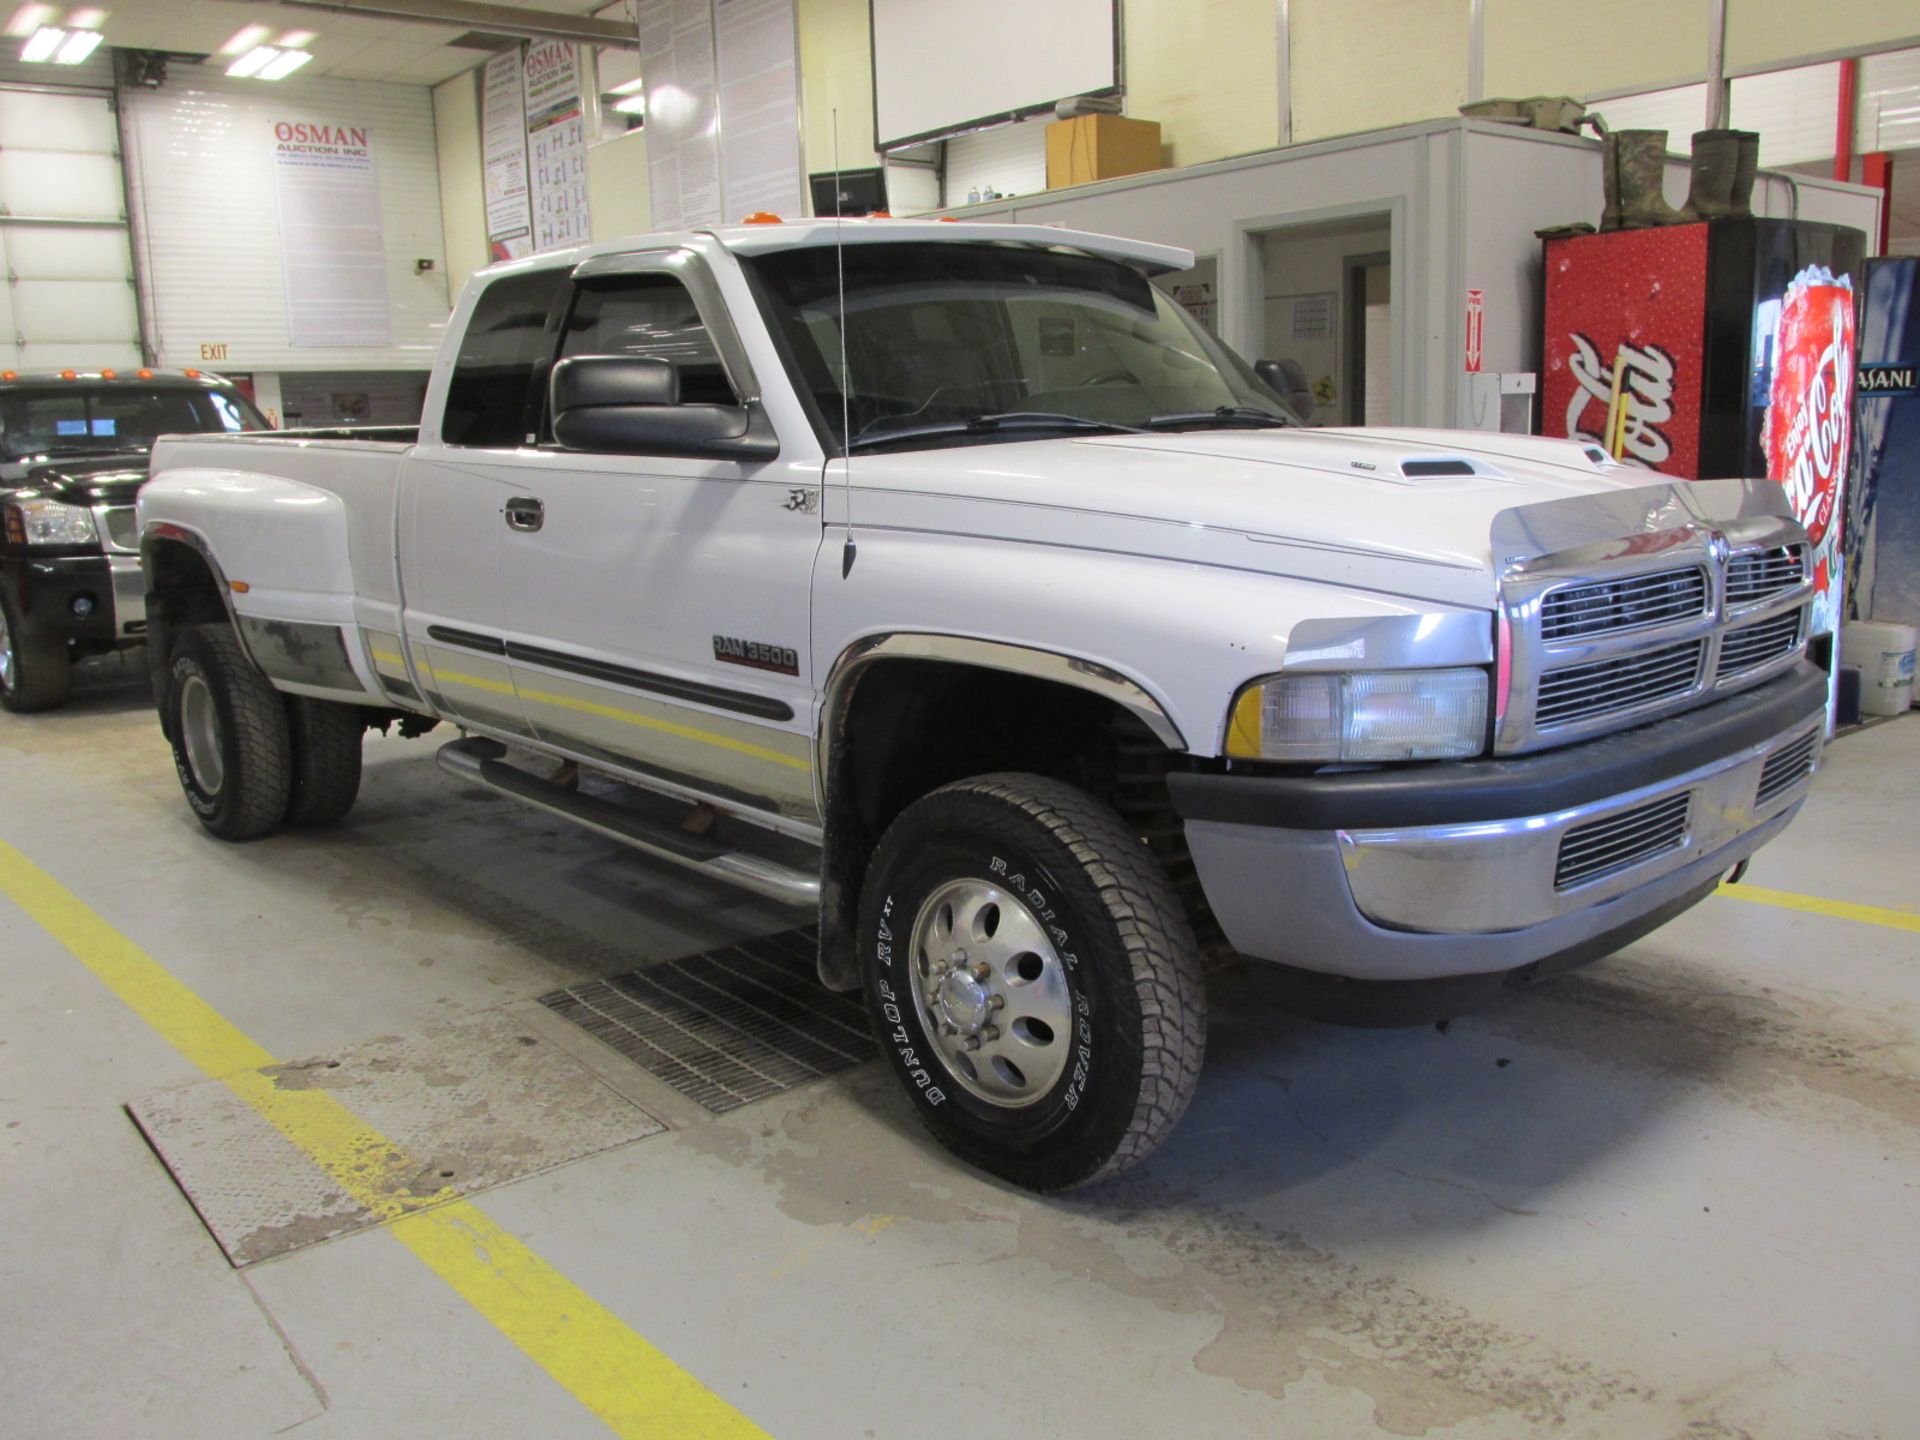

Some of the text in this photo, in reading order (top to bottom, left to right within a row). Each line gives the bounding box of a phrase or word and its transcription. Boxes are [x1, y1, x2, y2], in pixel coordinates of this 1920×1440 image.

[527, 40, 574, 78] OSMAN
[528, 68, 560, 88] AUCTION
[275, 121, 369, 147] OSMAN
[277, 143, 368, 157] AUCTION INC
[200, 344, 229, 361] EXIT
[1785, 397, 1810, 458] Enjoy
[713, 634, 746, 657] RAM
[747, 641, 797, 667] 3500
[877, 916, 895, 967] RV
[989, 855, 1091, 1112] RADIAL ROVER
[878, 979, 947, 1106] DUNLOP
